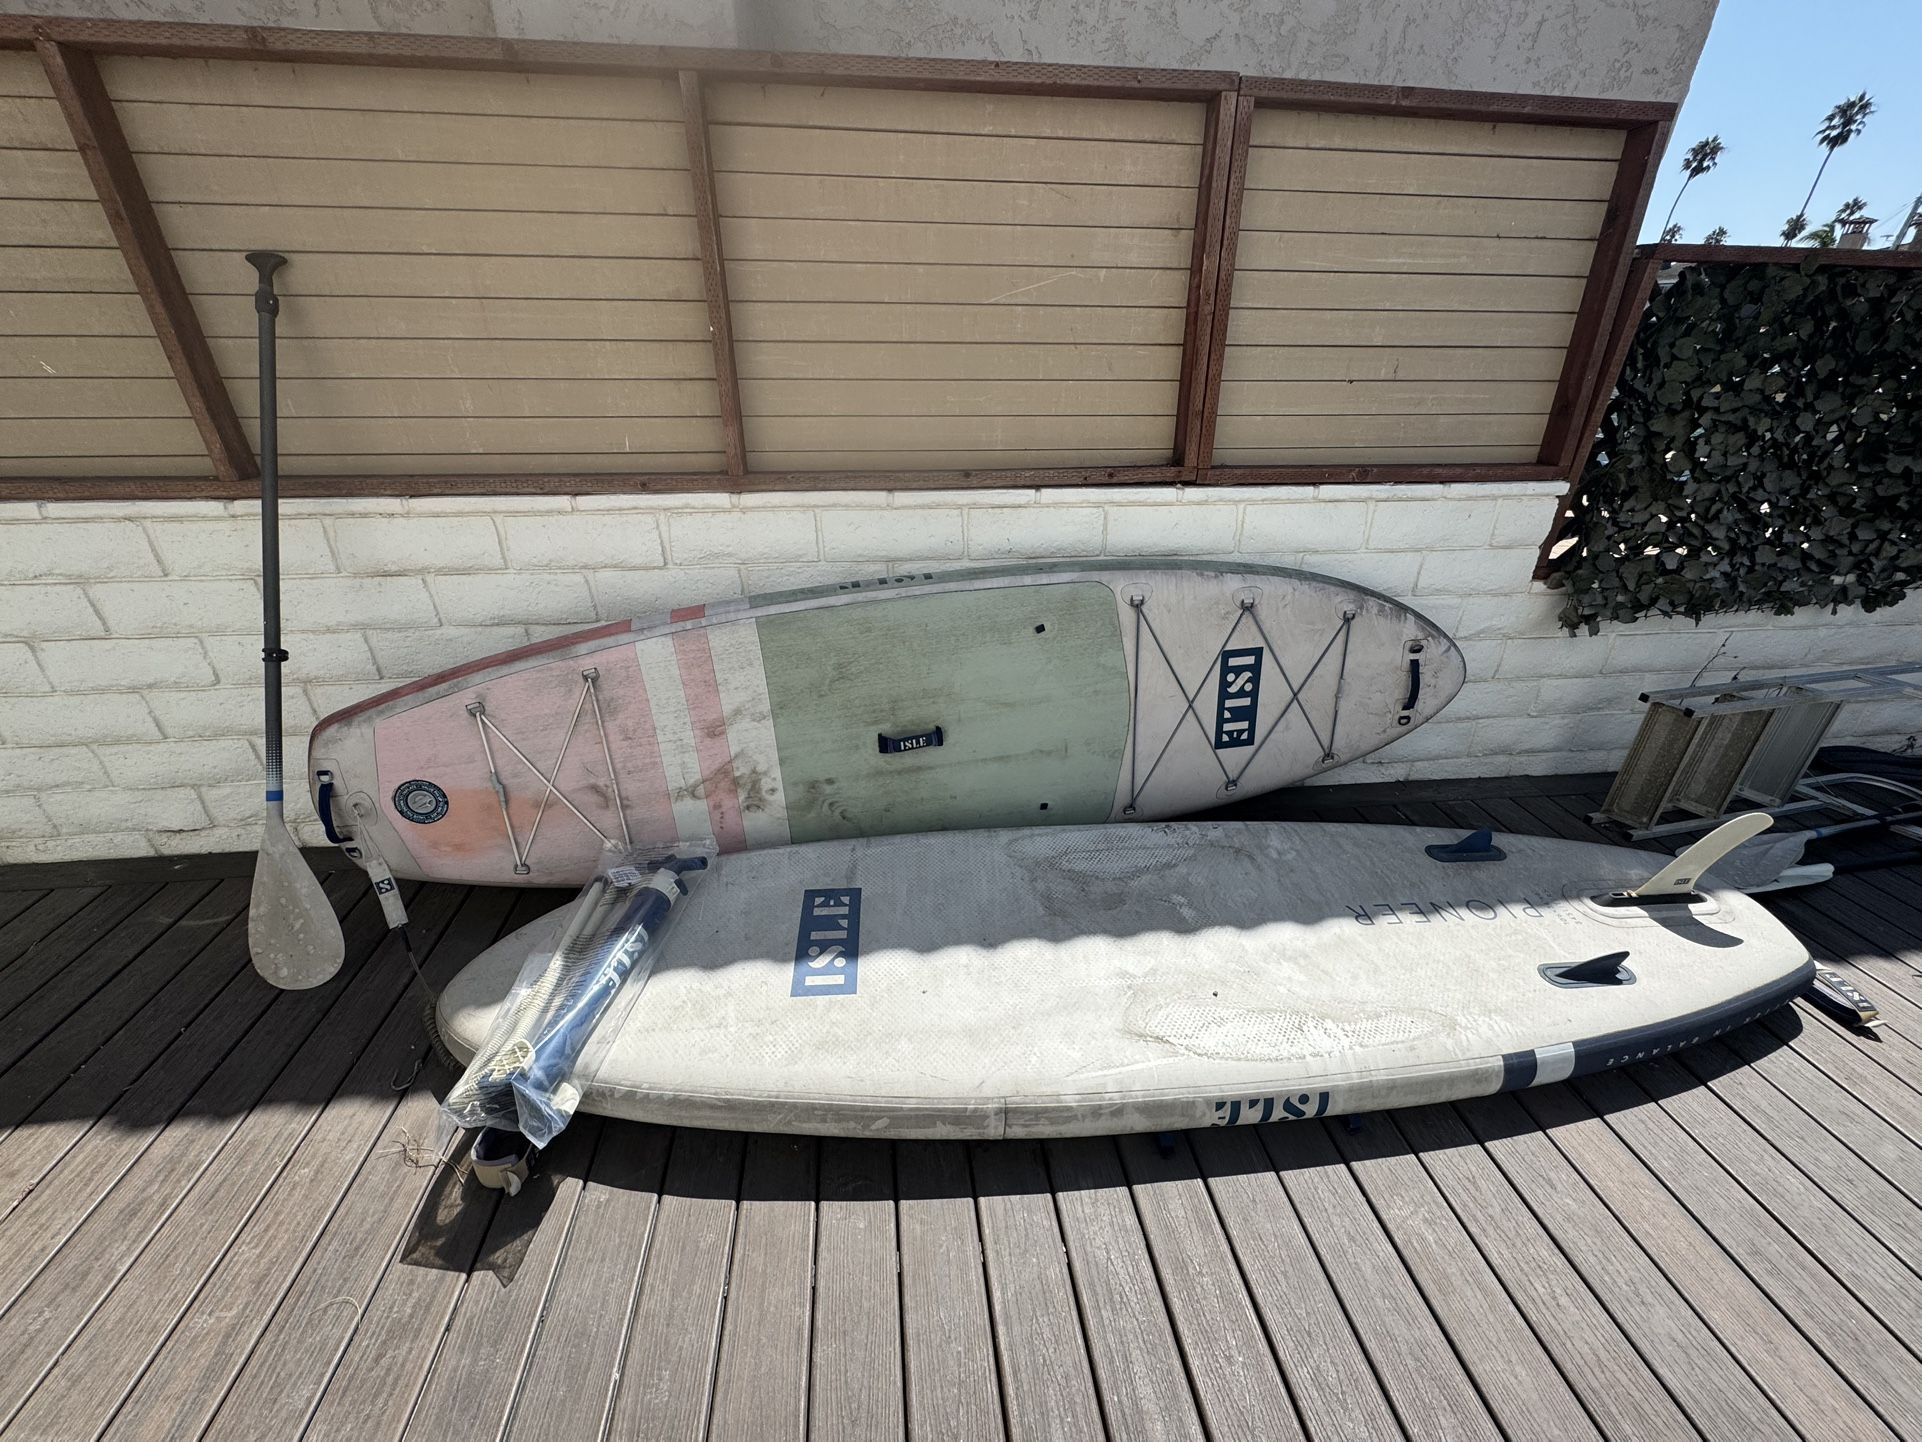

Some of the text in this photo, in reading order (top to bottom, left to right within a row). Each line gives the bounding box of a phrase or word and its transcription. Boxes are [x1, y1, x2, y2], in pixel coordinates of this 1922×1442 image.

[1222, 655, 1256, 742] ISLE
[900, 736, 927, 751] ISLE
[1345, 897, 1544, 926] PIONEER
[804, 896, 850, 986] ISLE
[1606, 1036, 1700, 1066] BALANCE
[1210, 1091, 1330, 1128] ISLE
